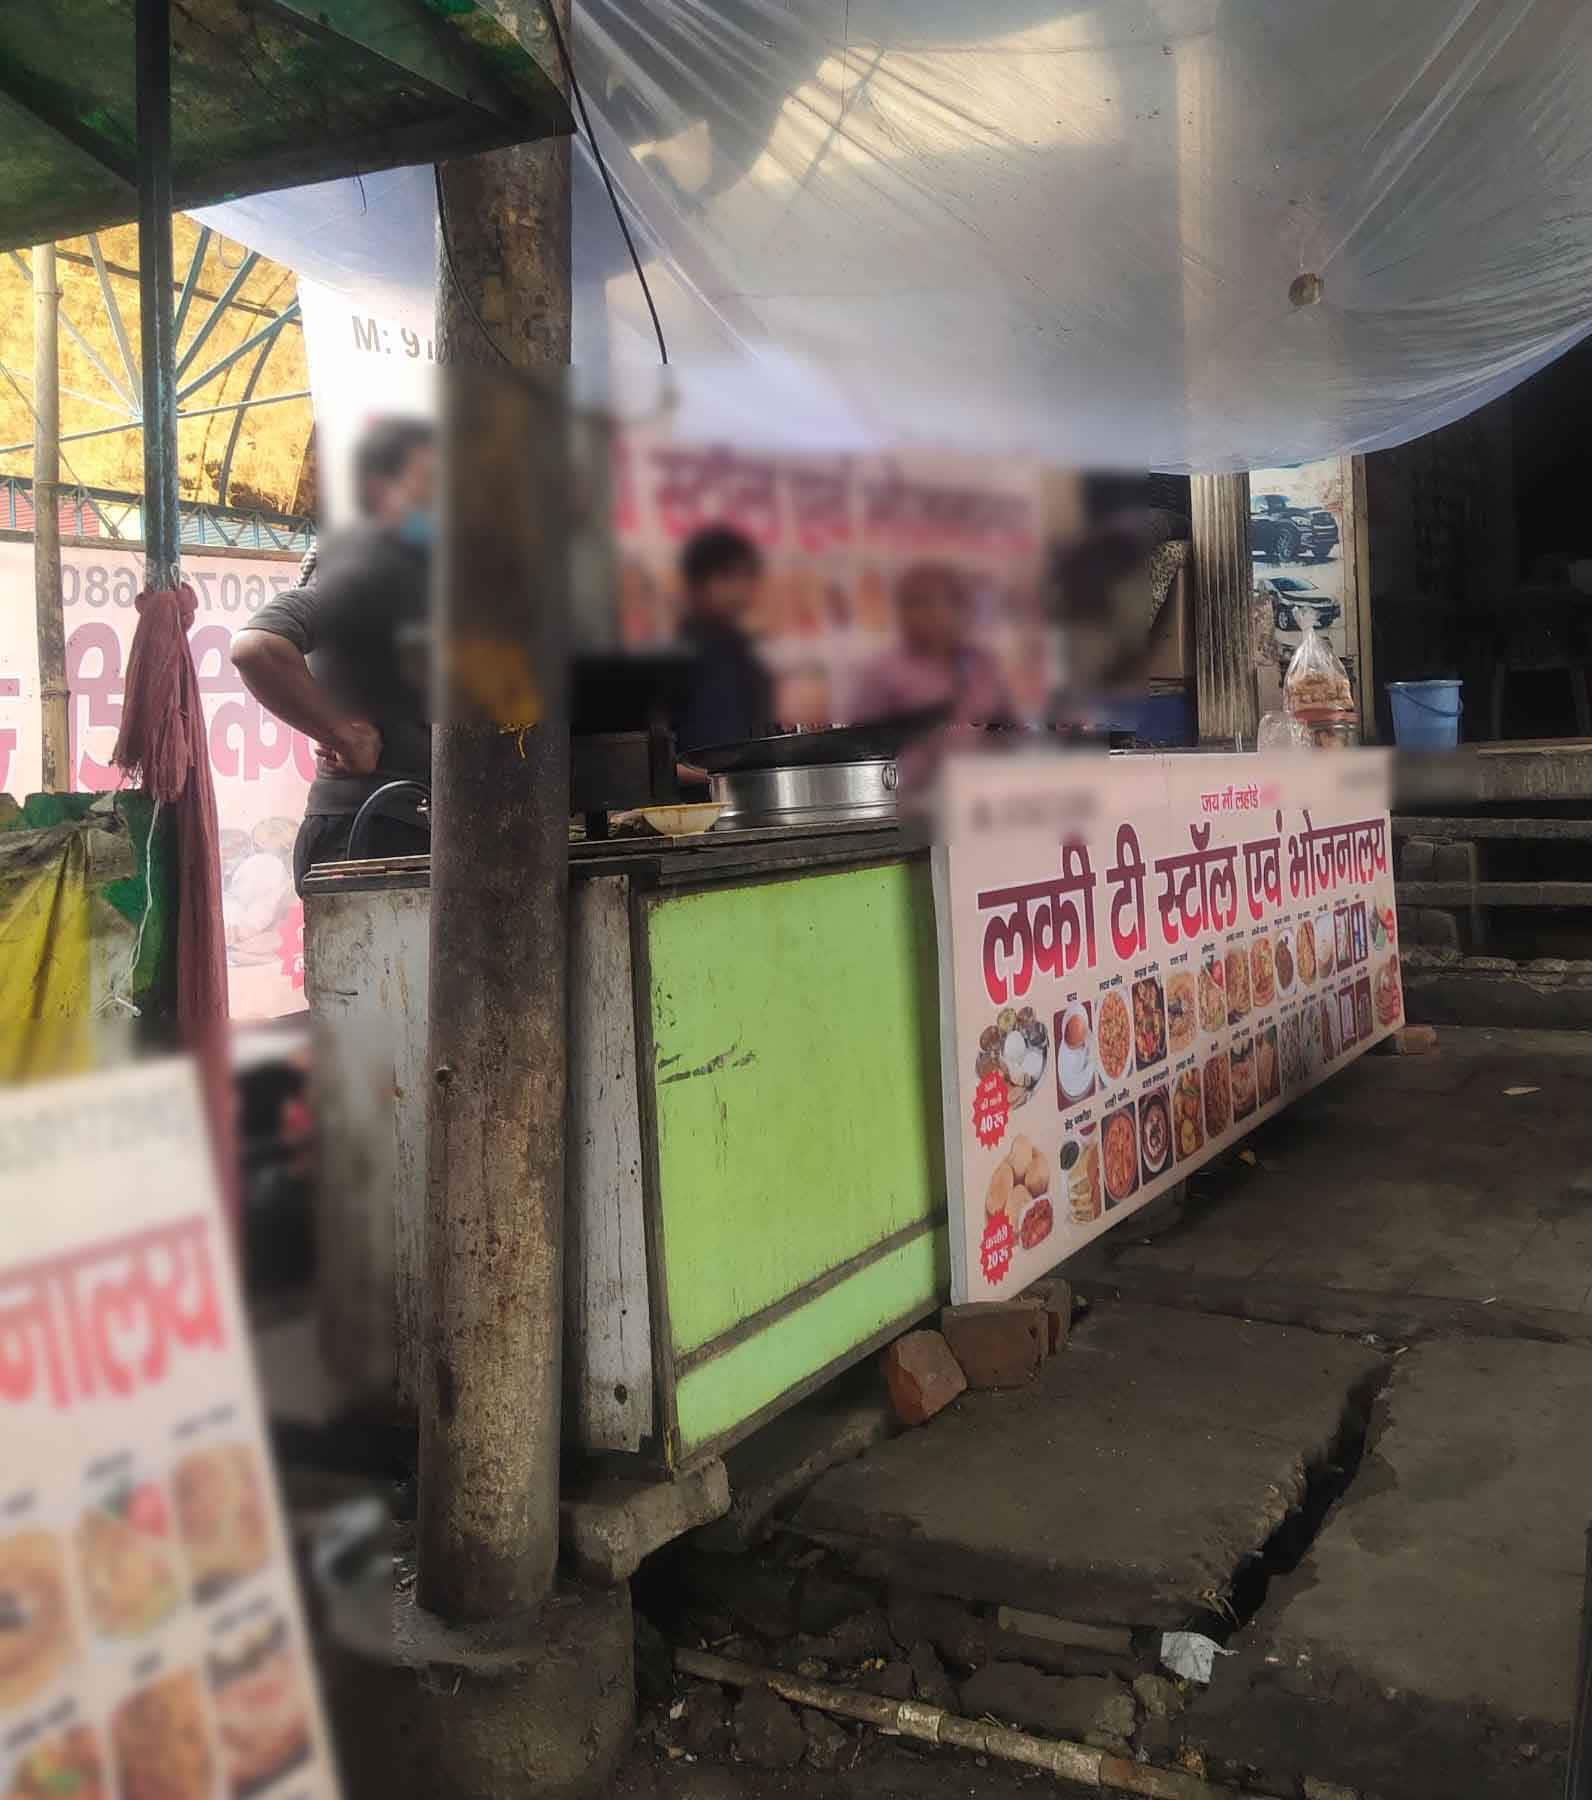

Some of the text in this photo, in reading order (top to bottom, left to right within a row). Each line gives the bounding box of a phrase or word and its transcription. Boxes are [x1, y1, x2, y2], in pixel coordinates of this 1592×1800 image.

[1200, 792, 1220, 814] जय
[977, 809, 1390, 1006] लकी टी स्टॉल एवं भोजनालय
